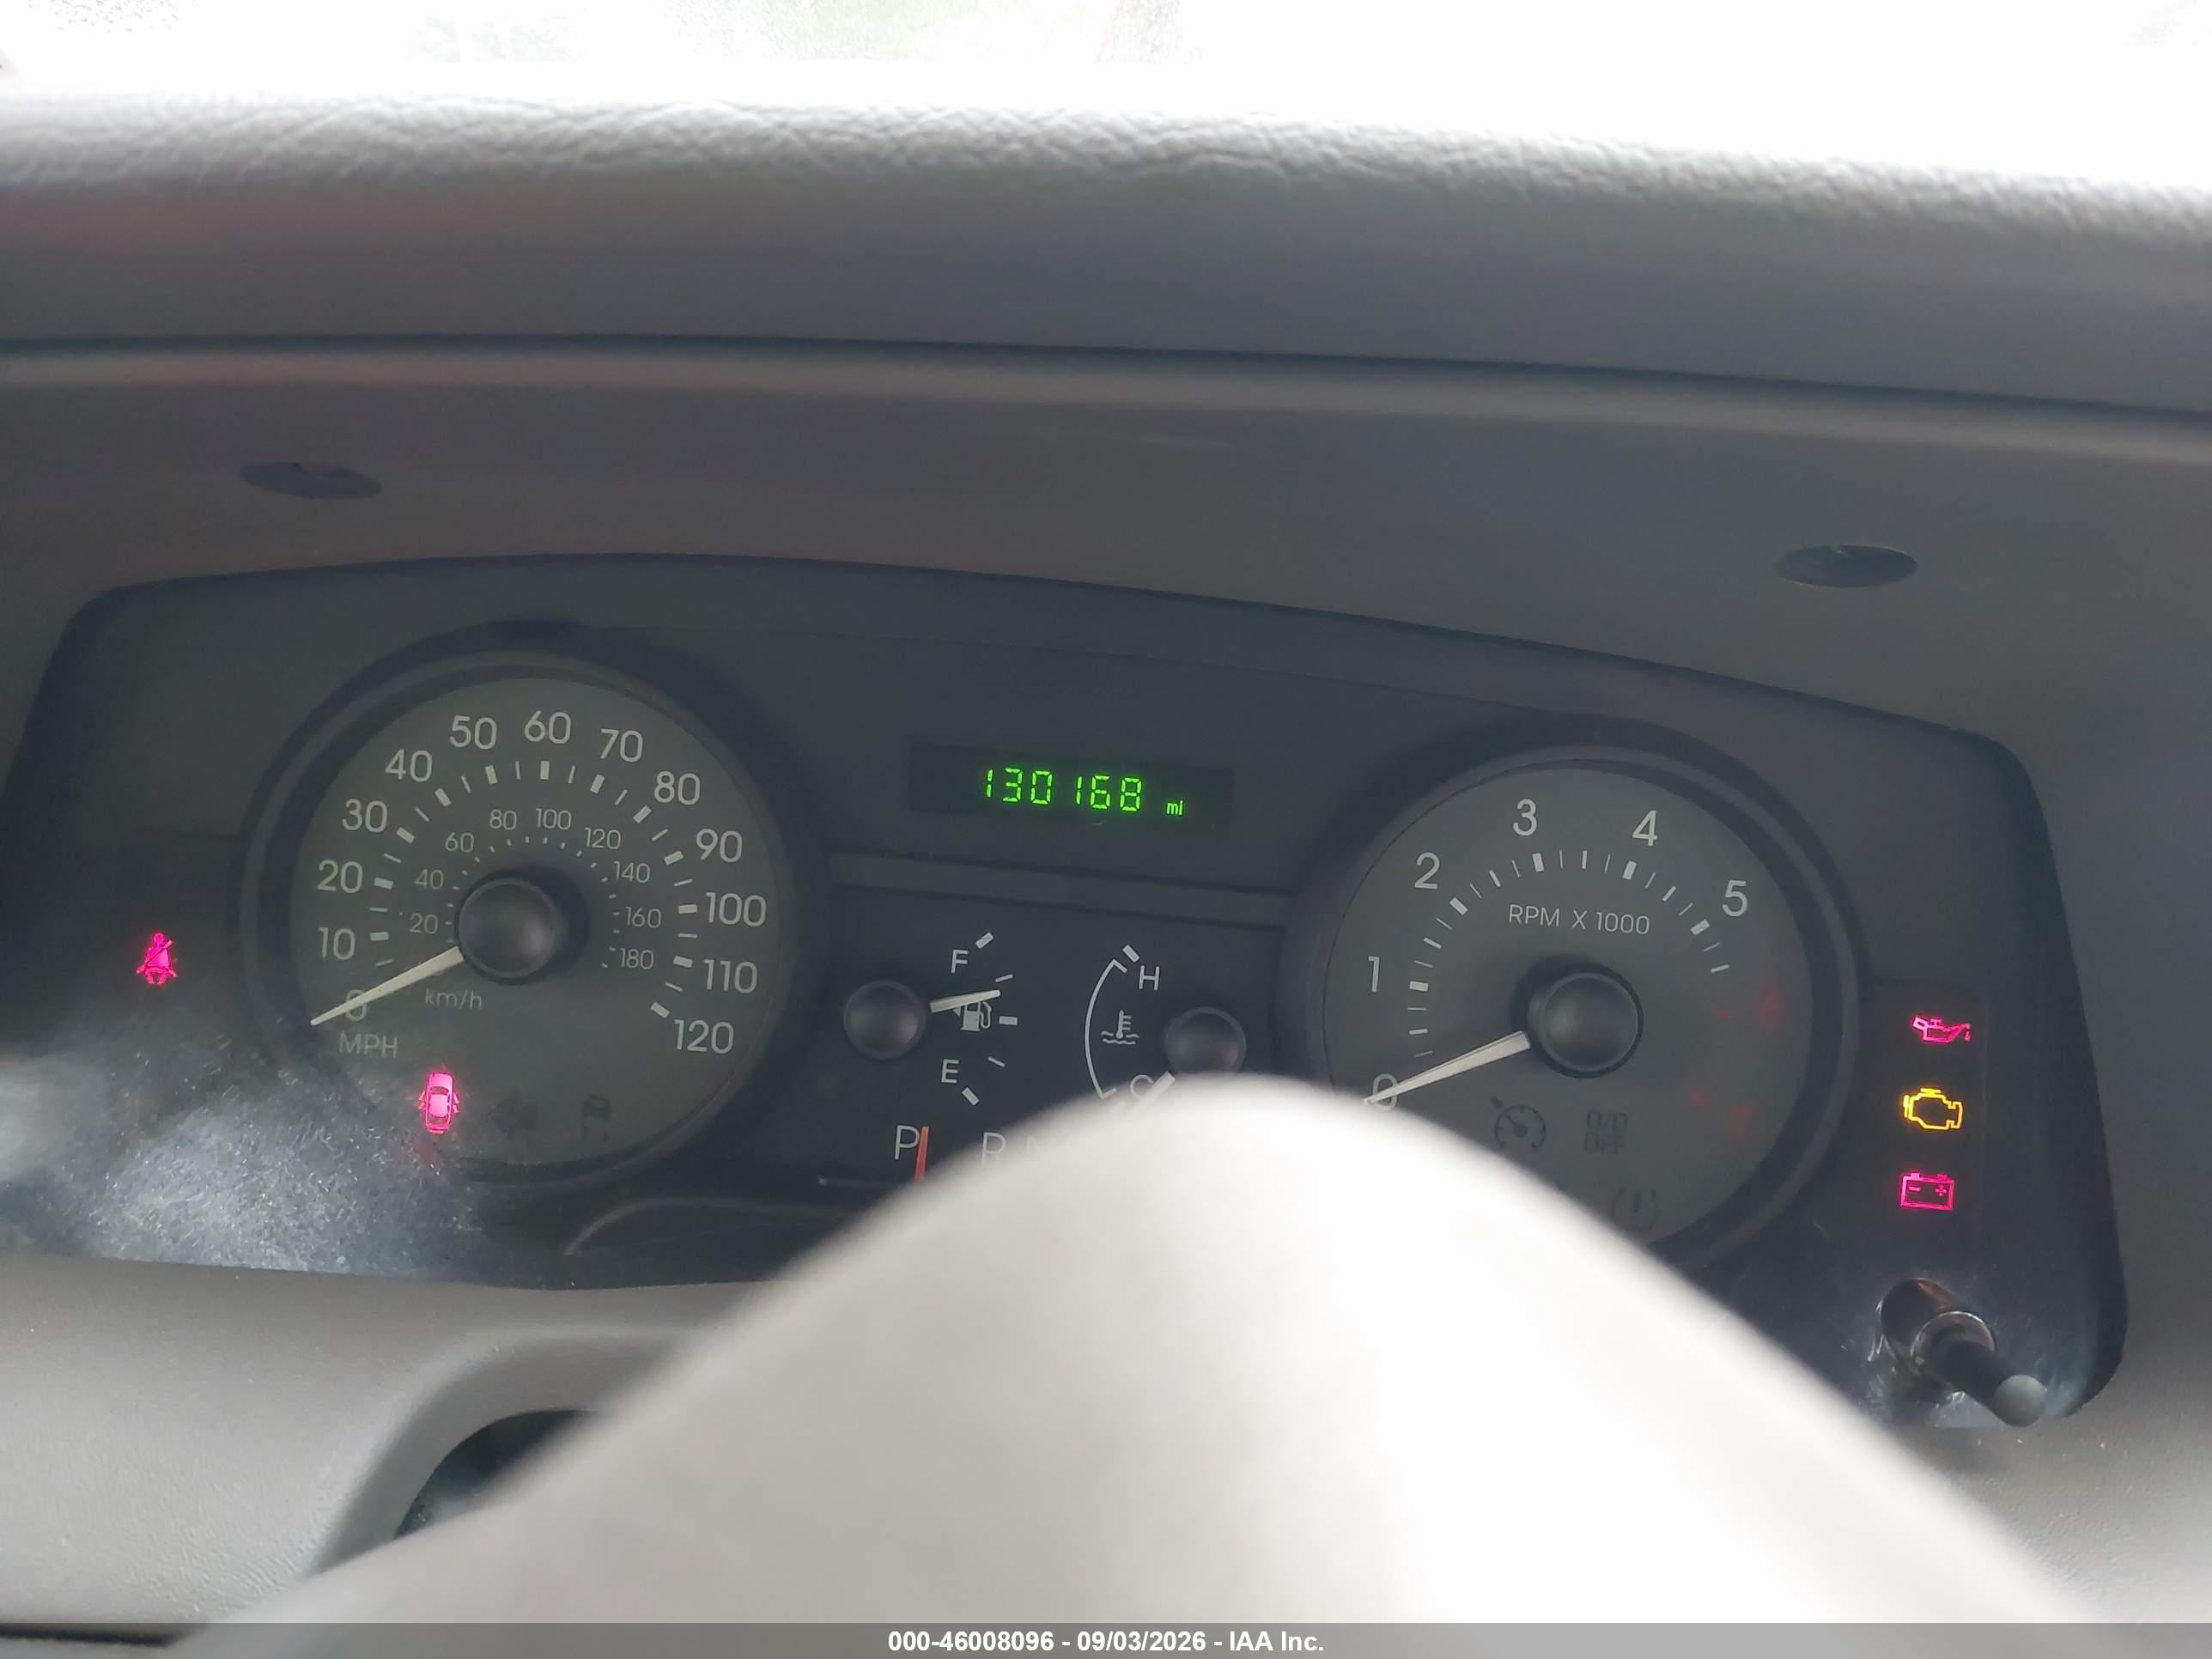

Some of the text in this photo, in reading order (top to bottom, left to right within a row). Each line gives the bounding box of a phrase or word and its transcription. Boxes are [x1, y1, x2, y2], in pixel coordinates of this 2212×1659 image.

[449, 717, 497, 749] 50
[524, 710, 572, 744] 60
[601, 728, 643, 762] 70
[386, 750, 432, 781] 40
[654, 771, 700, 805] 80
[986, 768, 1183, 815] 130168 mi
[343, 799, 387, 833] 30
[489, 811, 517, 830] 80
[536, 809, 571, 830] 100
[1513, 799, 1537, 836] 3
[1632, 810, 1657, 846] 4
[445, 833, 474, 853] 60
[585, 828, 621, 849] 120
[696, 830, 743, 862] 90
[317, 861, 362, 893] 20
[415, 870, 444, 890] 40
[614, 861, 650, 883] 140
[1415, 853, 1440, 889] 2
[706, 892, 767, 927] 100
[1723, 880, 1748, 916] 5
[409, 915, 438, 933] 20
[626, 907, 661, 927] 160
[1509, 904, 1650, 934] RPM X 1000
[319, 927, 355, 960] 10
[620, 949, 654, 969] 180
[703, 960, 757, 993] 110
[951, 950, 969, 973] F
[1139, 965, 1159, 990] H
[1369, 956, 1380, 992] 1
[346, 989, 367, 1021] 0
[425, 988, 483, 1010] km/h
[339, 1033, 398, 1057] MPH
[674, 1019, 734, 1054] 120
[941, 1060, 958, 1084] E
[1373, 1073, 1398, 1110] 0
[894, 1125, 920, 1160] P
